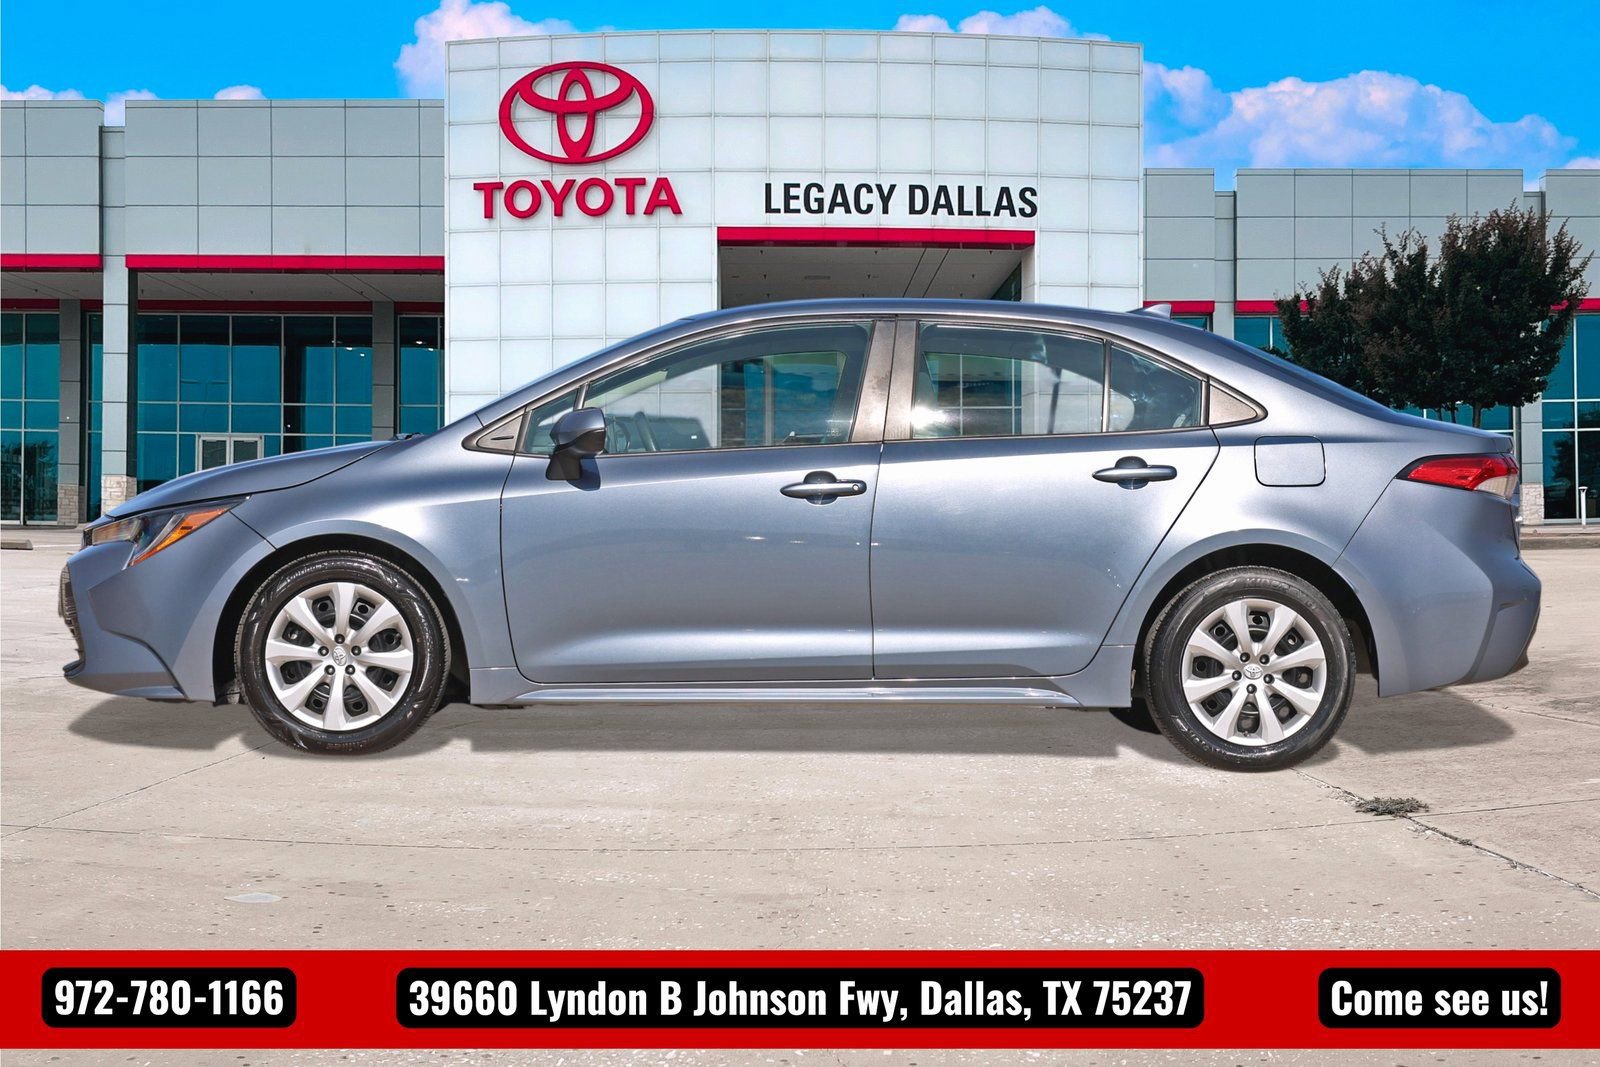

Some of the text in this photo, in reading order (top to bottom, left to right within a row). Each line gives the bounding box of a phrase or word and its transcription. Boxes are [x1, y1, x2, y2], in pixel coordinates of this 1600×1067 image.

[474, 178, 681, 219] TOYOTA
[764, 182, 1038, 217] LEGACY DALLAS
